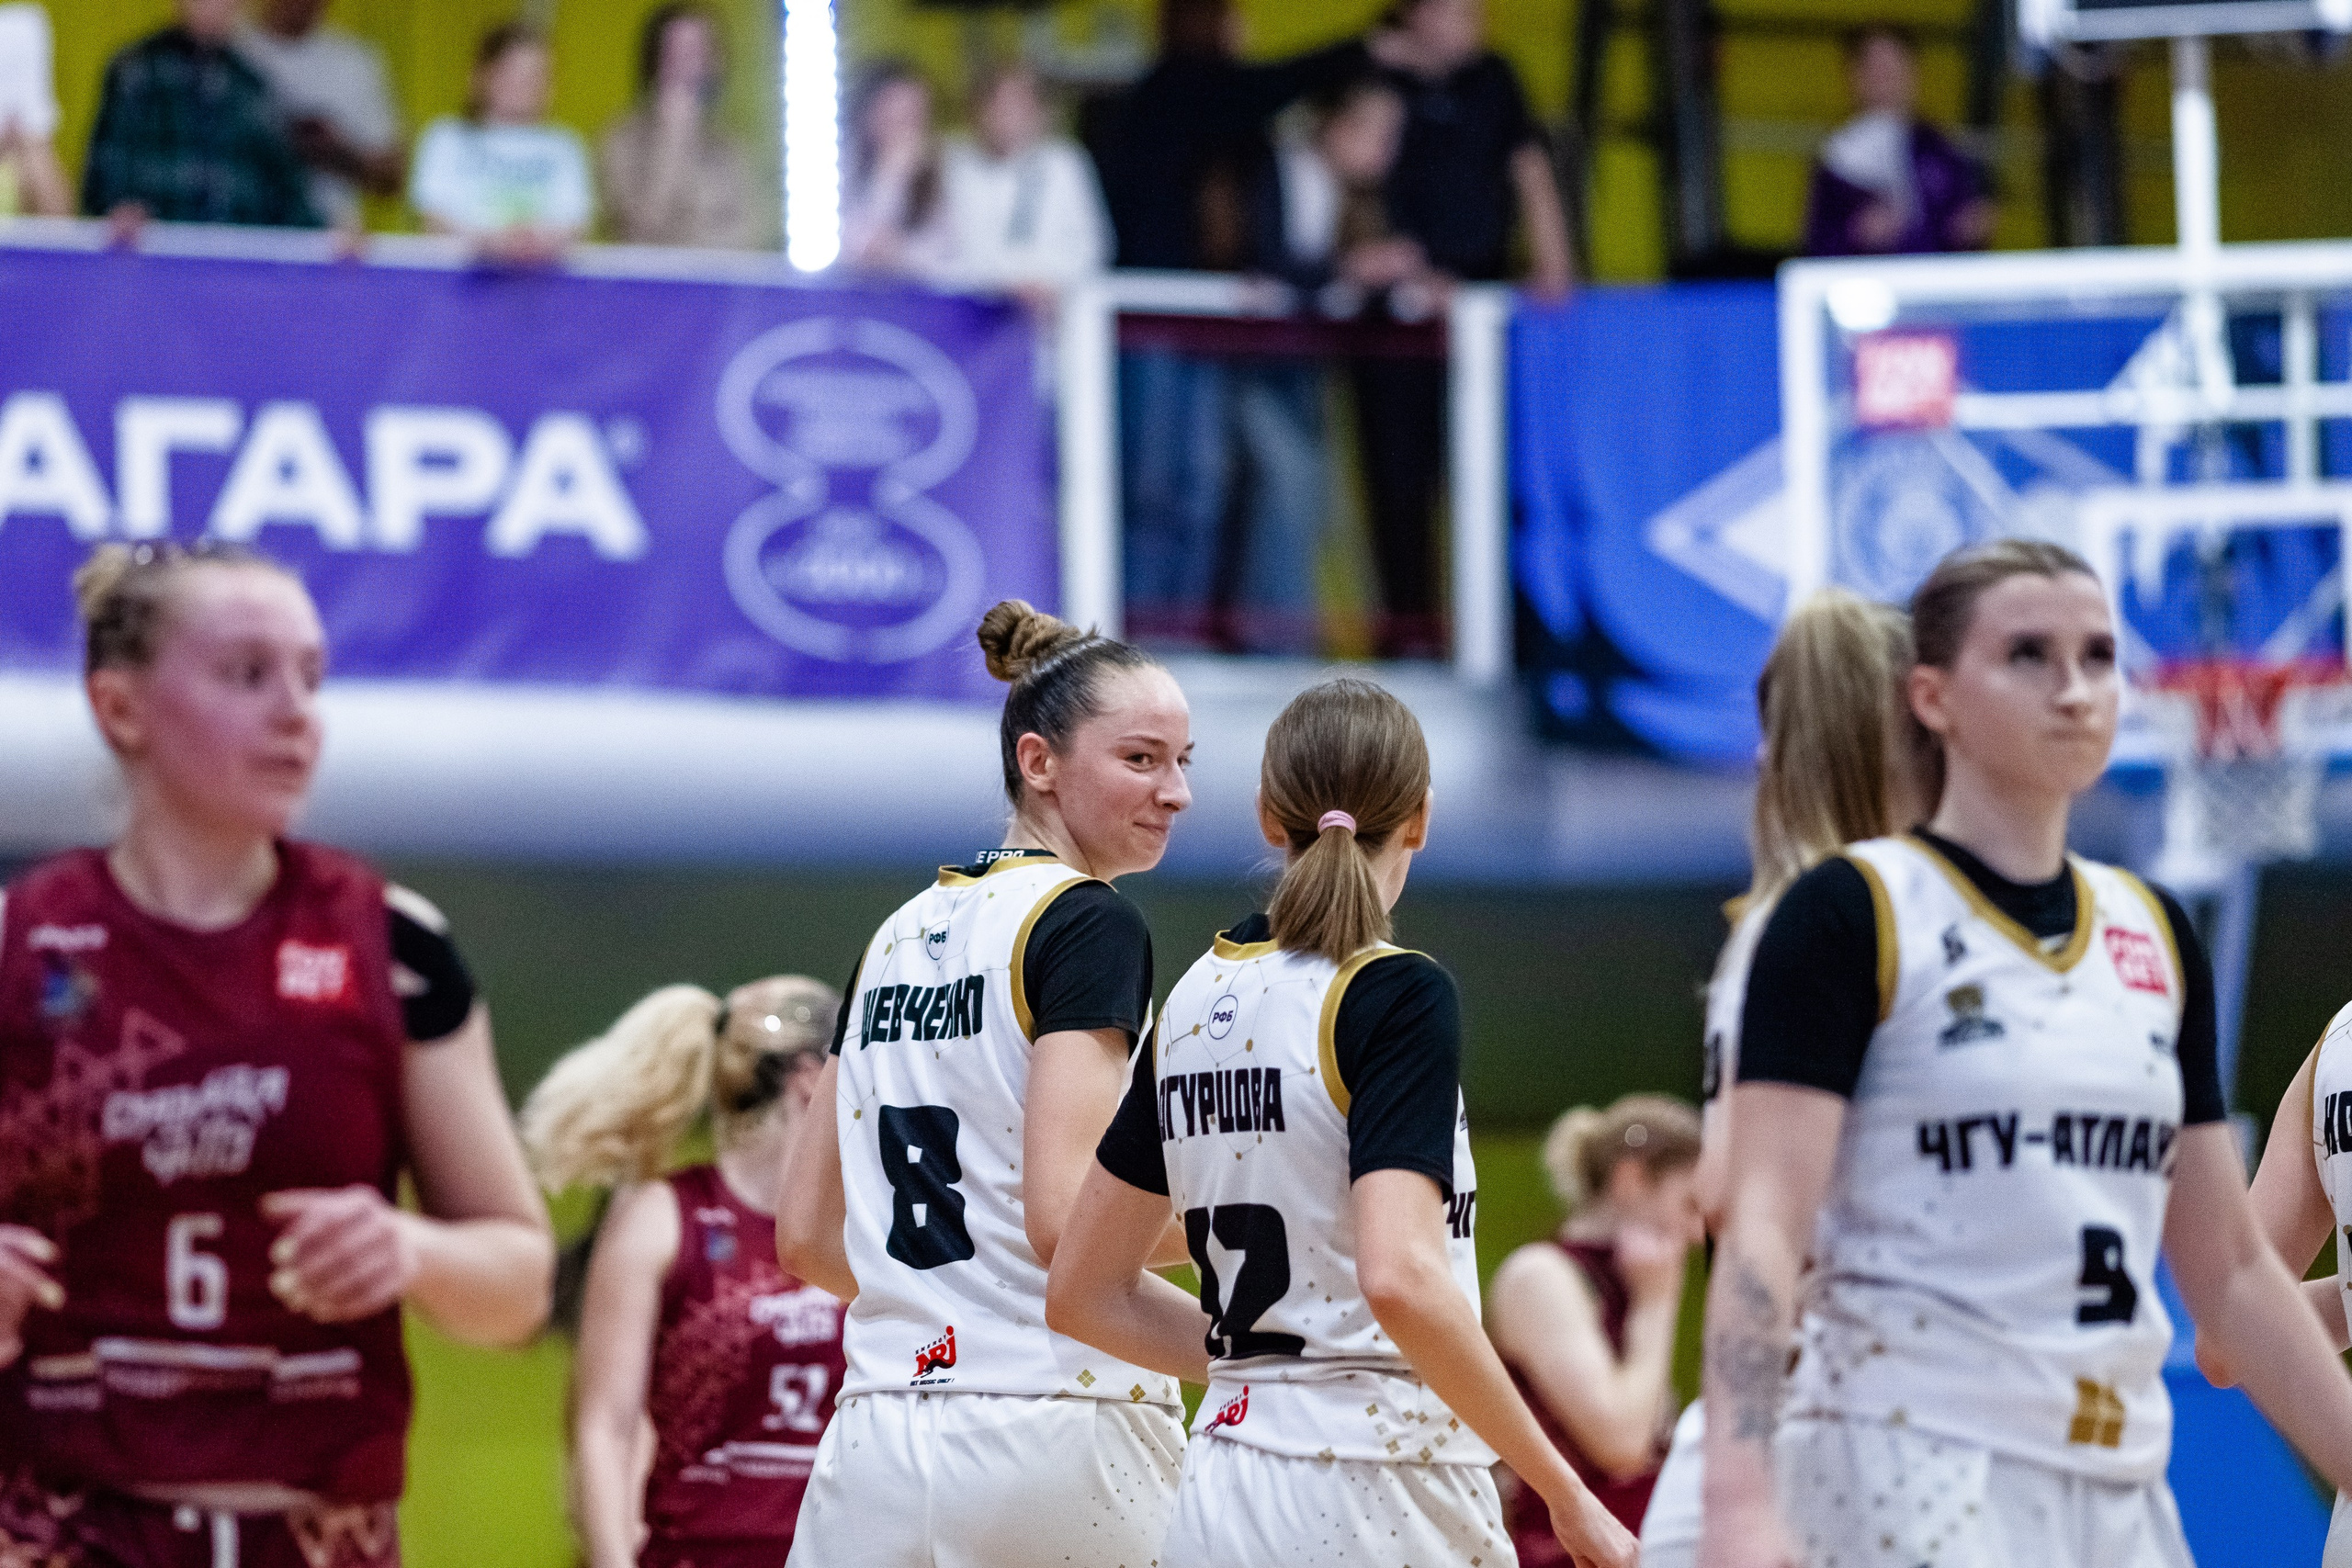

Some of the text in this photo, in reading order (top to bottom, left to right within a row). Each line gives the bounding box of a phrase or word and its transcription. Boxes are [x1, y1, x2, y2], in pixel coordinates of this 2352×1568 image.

[0, 389, 647, 561] АГАРА
[928, 931, 947, 945] РФБ
[1212, 1010, 1234, 1024] РФБ
[878, 1104, 976, 1270] 8
[165, 1212, 229, 1330] 6
[912, 1325, 957, 1378] NRJ
